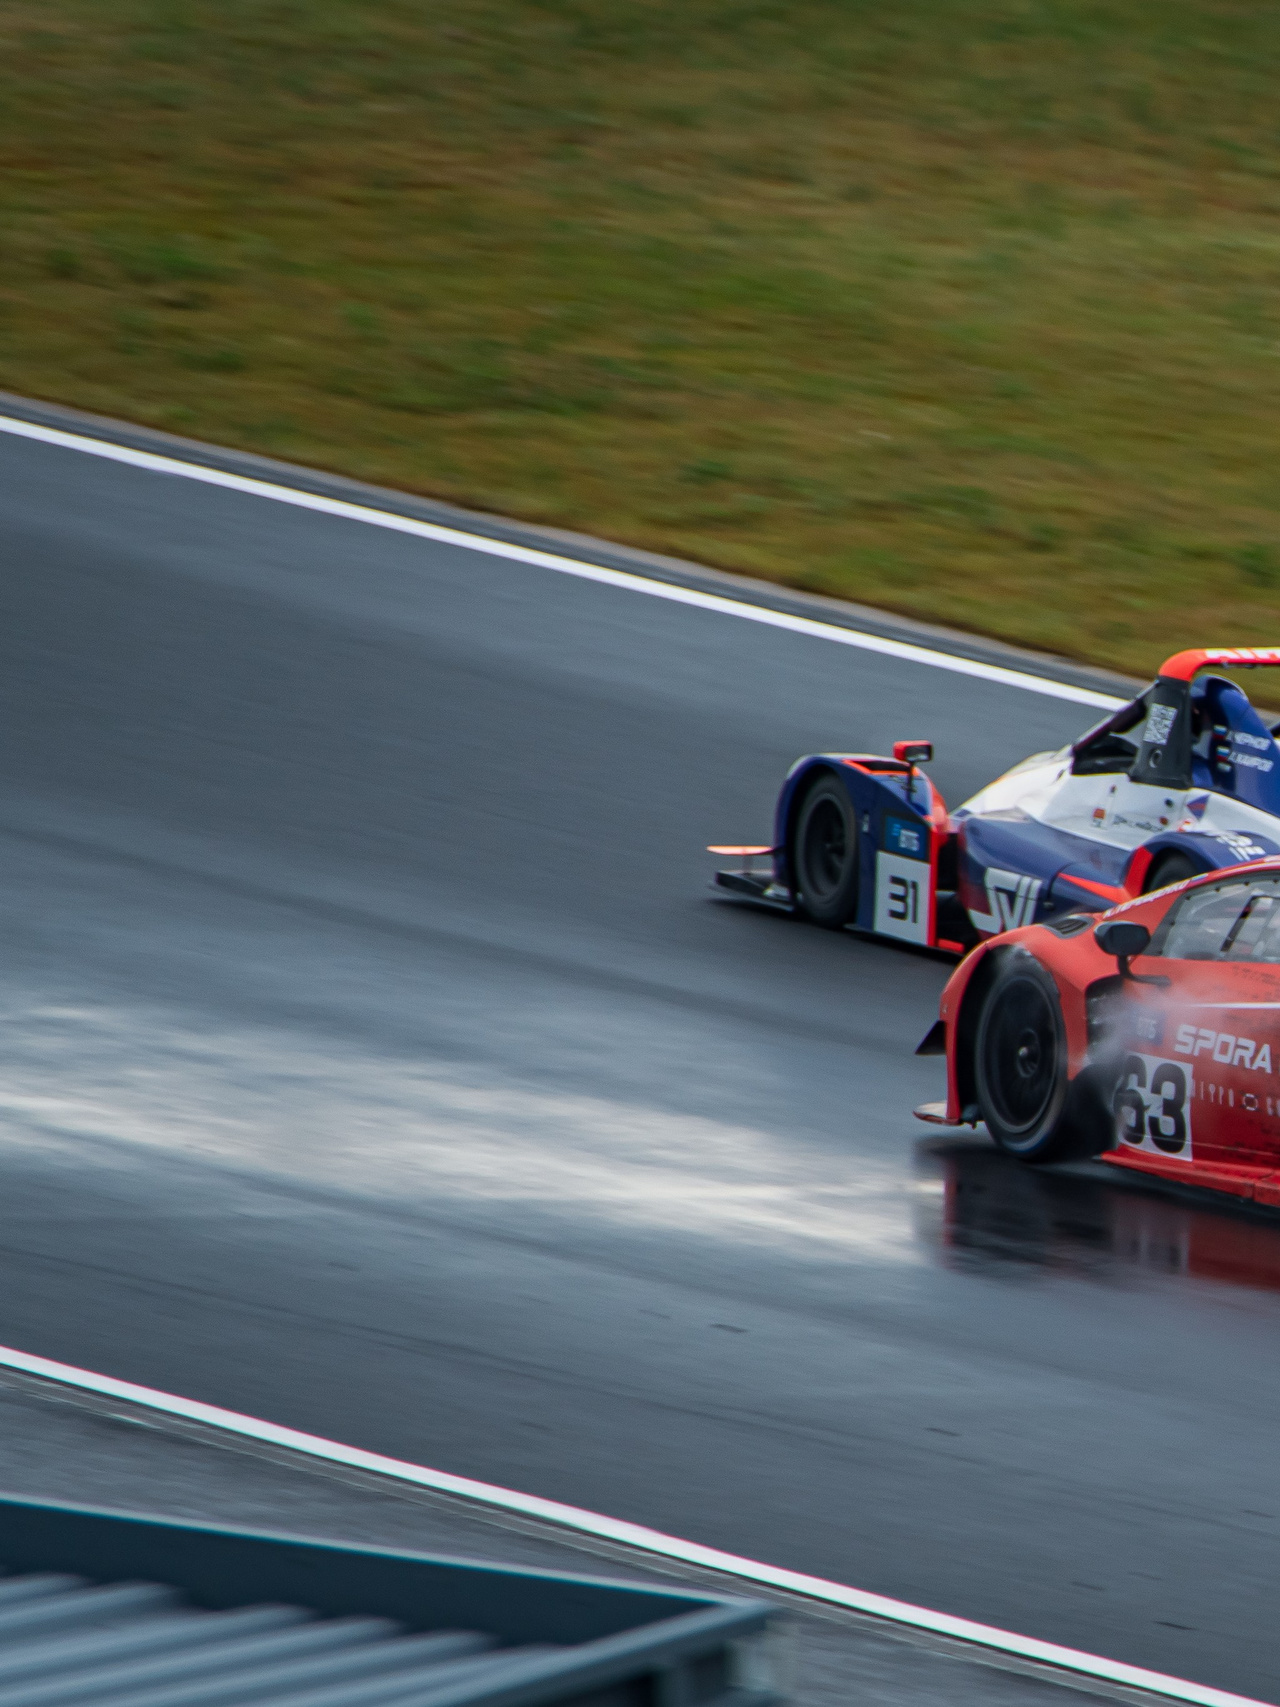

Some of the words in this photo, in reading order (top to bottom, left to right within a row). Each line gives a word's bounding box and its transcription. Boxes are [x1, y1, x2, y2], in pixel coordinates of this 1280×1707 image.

[888, 875, 919, 924] 31
[1174, 1024, 1273, 1074] SPORA
[1114, 1054, 1187, 1154] 63
